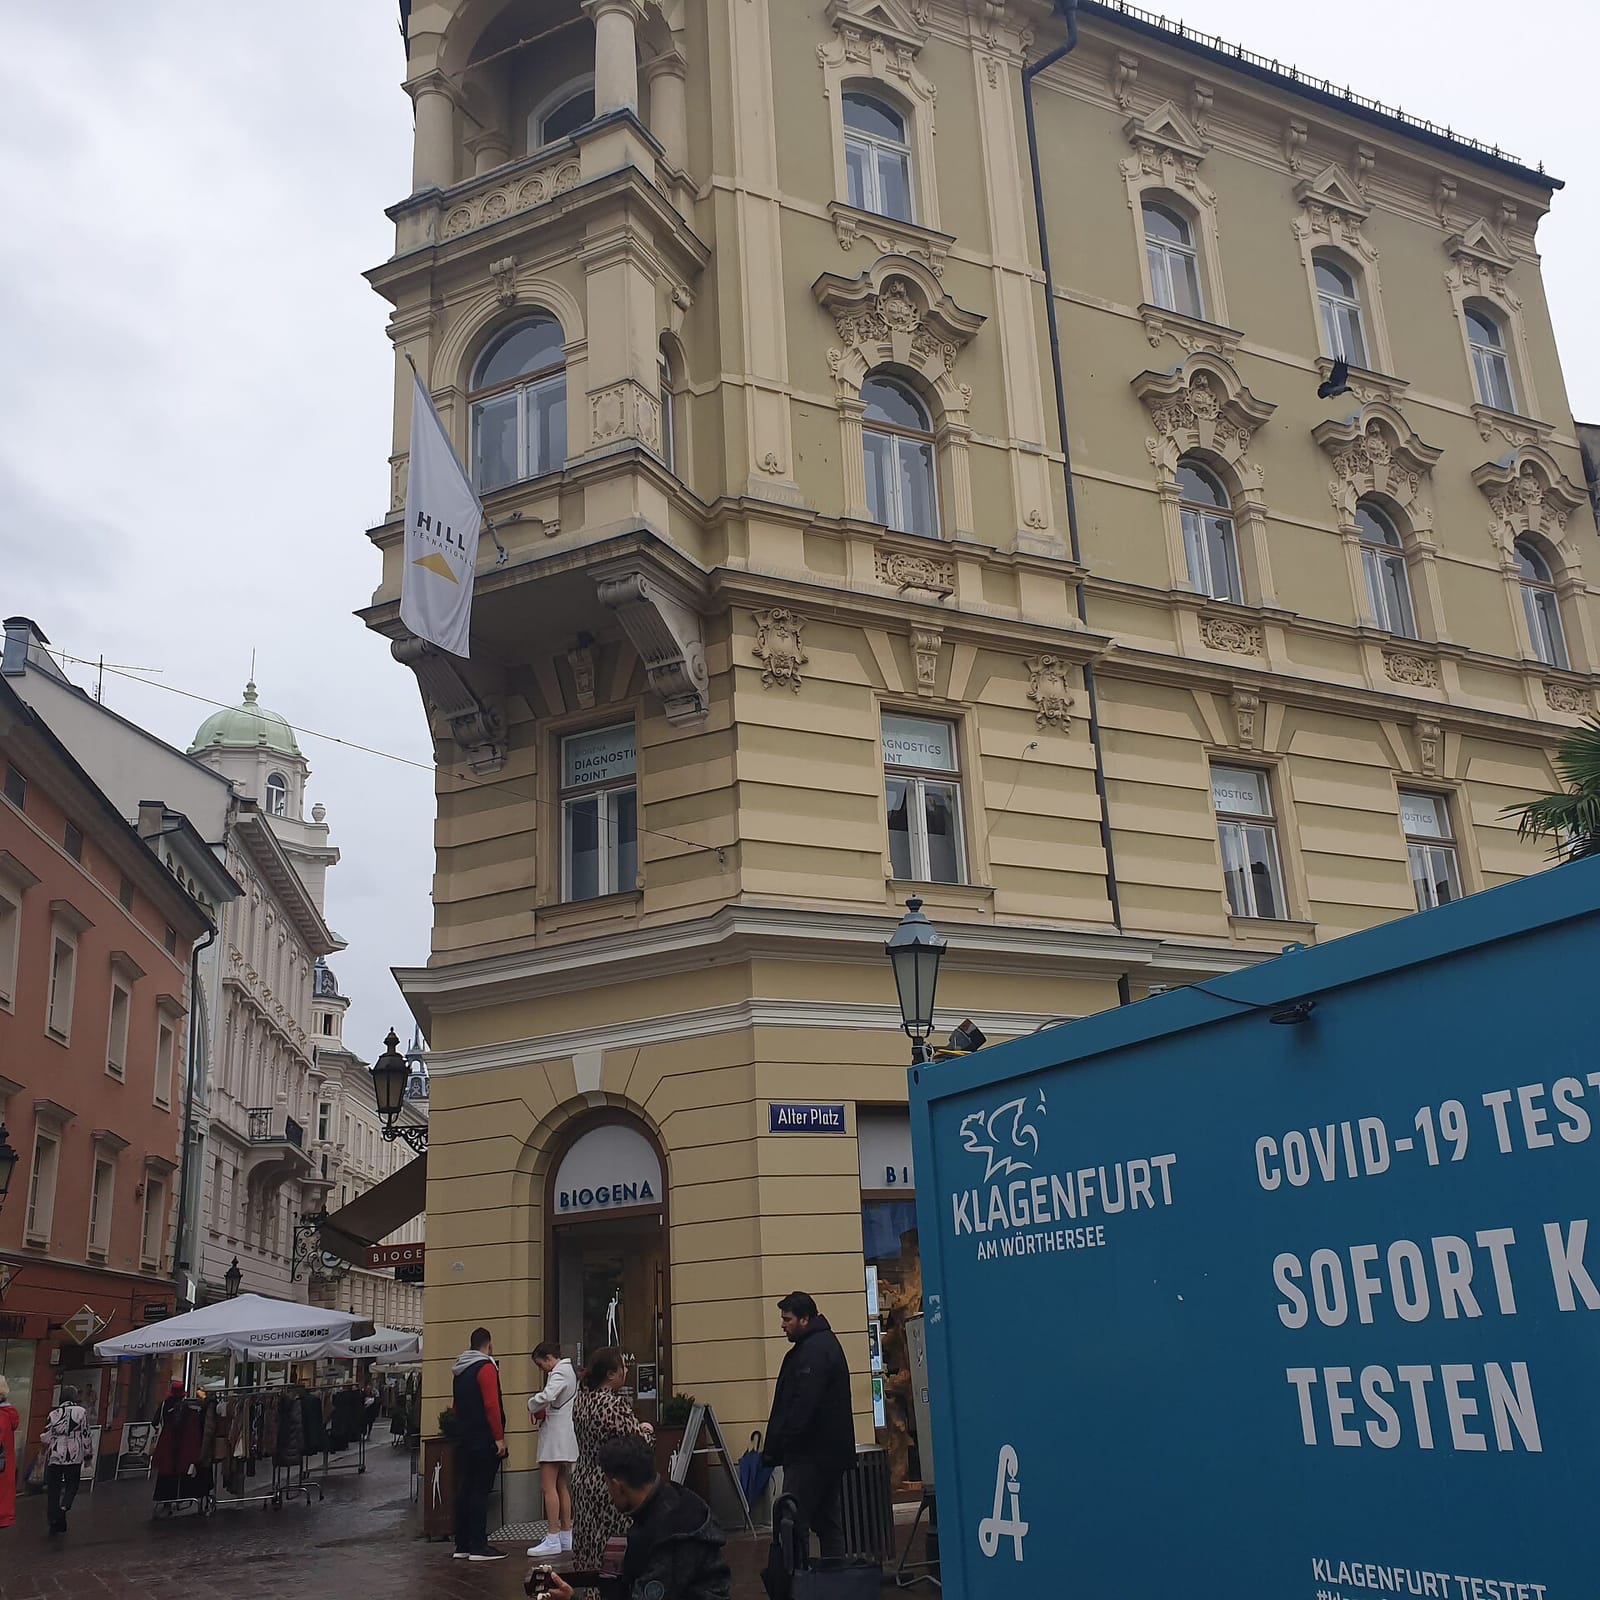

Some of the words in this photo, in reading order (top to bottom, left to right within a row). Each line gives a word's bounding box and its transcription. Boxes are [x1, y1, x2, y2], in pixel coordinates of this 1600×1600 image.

[417, 511, 465, 551] HILL
[574, 747, 637, 770] DIAGNOSTI
[574, 768, 608, 784] POINT
[778, 1108, 808, 1125] Alter
[810, 1108, 839, 1126] Platz
[1255, 1099, 1469, 1190] COVID-19
[560, 1180, 654, 1208] BIOGENA
[952, 1153, 1177, 1236] KLAGENFURT
[977, 1240, 999, 1260] AM
[1001, 1225, 1106, 1257] WÖRTHERSEE
[1272, 1227, 1517, 1329] SOFORT
[1286, 1361, 1543, 1452] TESTEN
[1312, 1557, 1450, 1599] KLAGENFURT
